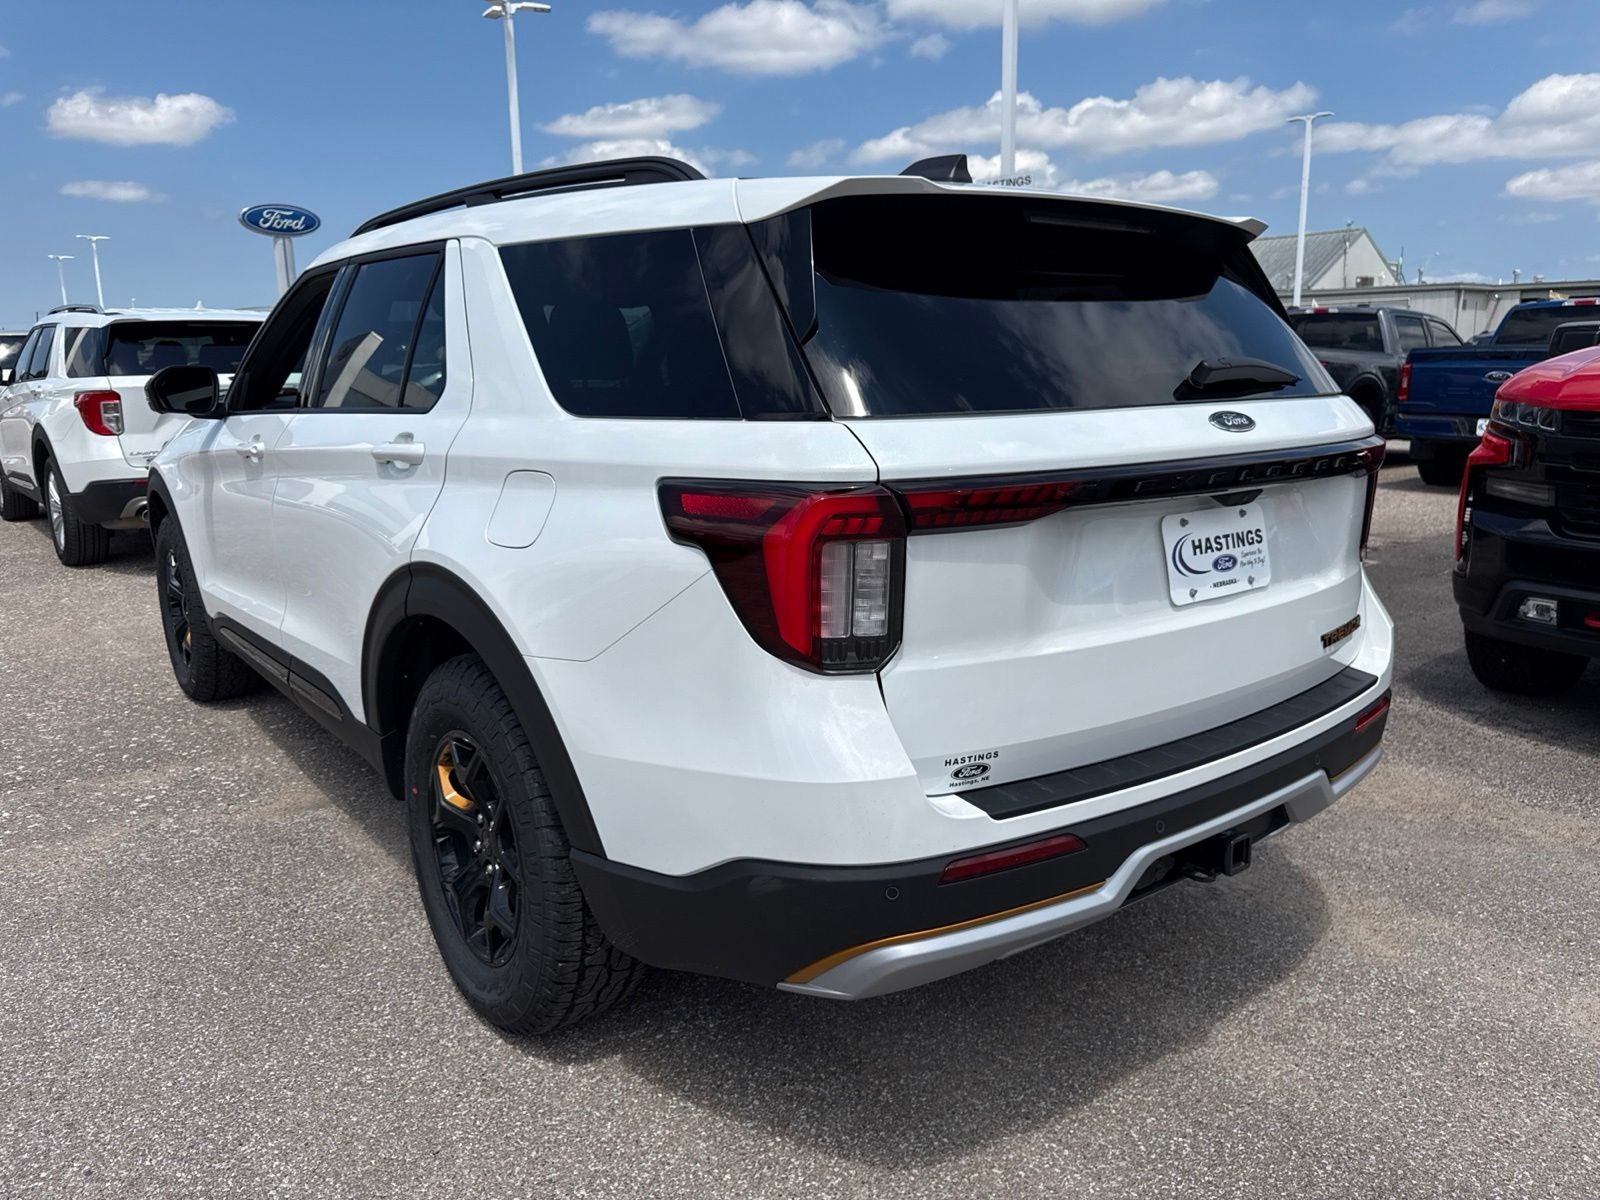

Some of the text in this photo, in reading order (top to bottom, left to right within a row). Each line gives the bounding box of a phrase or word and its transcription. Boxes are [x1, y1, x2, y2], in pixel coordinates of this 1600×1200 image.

[981, 175, 1032, 187] STINGS
[258, 208, 306, 231] Ford
[1222, 413, 1249, 426] Ford
[1191, 528, 1263, 556] HASTINGS
[1217, 556, 1234, 570] Ford
[1212, 578, 1237, 588] NEBRASKA
[944, 751, 999, 766] HASTINGS
[959, 765, 984, 778] Ford
[949, 779, 980, 787] Hastings,
